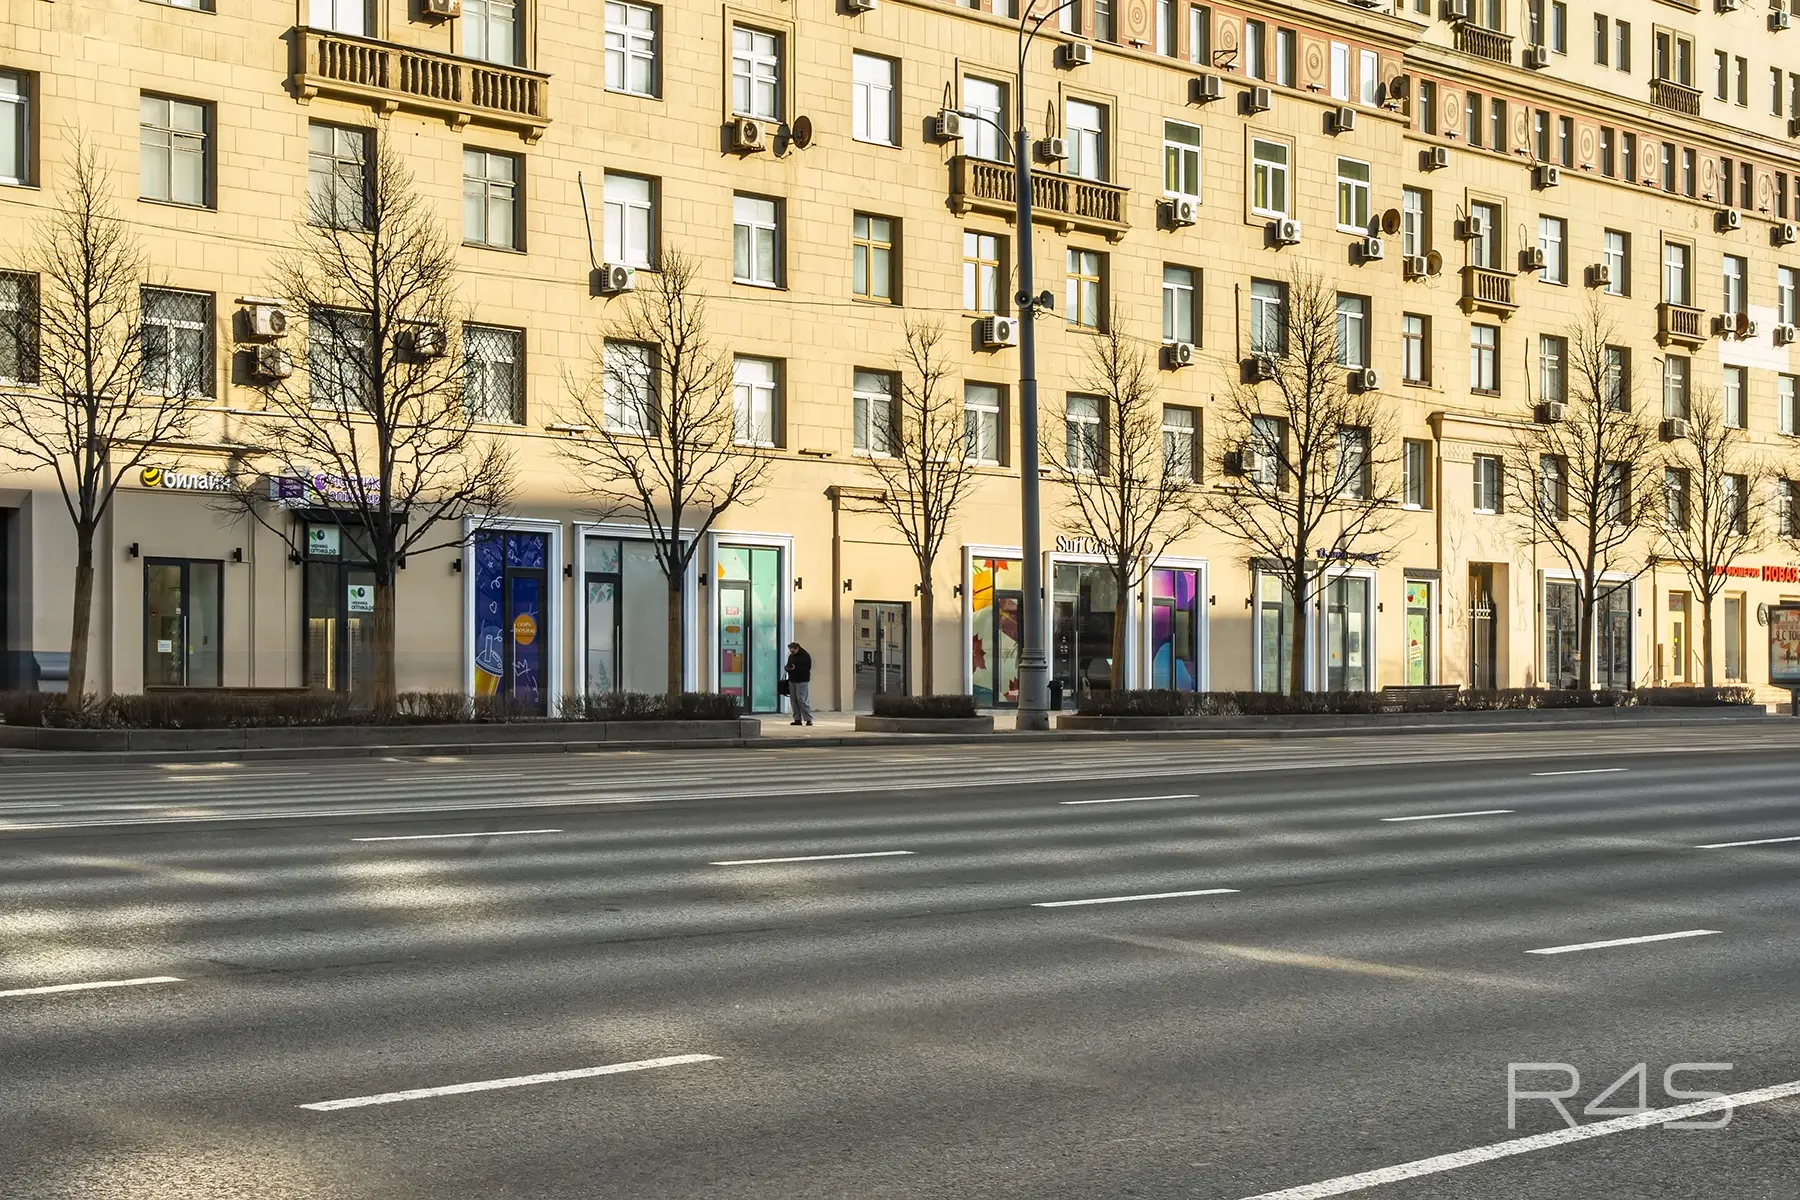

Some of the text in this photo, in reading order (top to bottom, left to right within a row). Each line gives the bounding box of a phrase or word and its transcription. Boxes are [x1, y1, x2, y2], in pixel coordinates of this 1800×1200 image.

[163, 469, 231, 491] билайн
[1056, 533, 1083, 553] Surf
[1762, 566, 1798, 583] НОВАЯ
